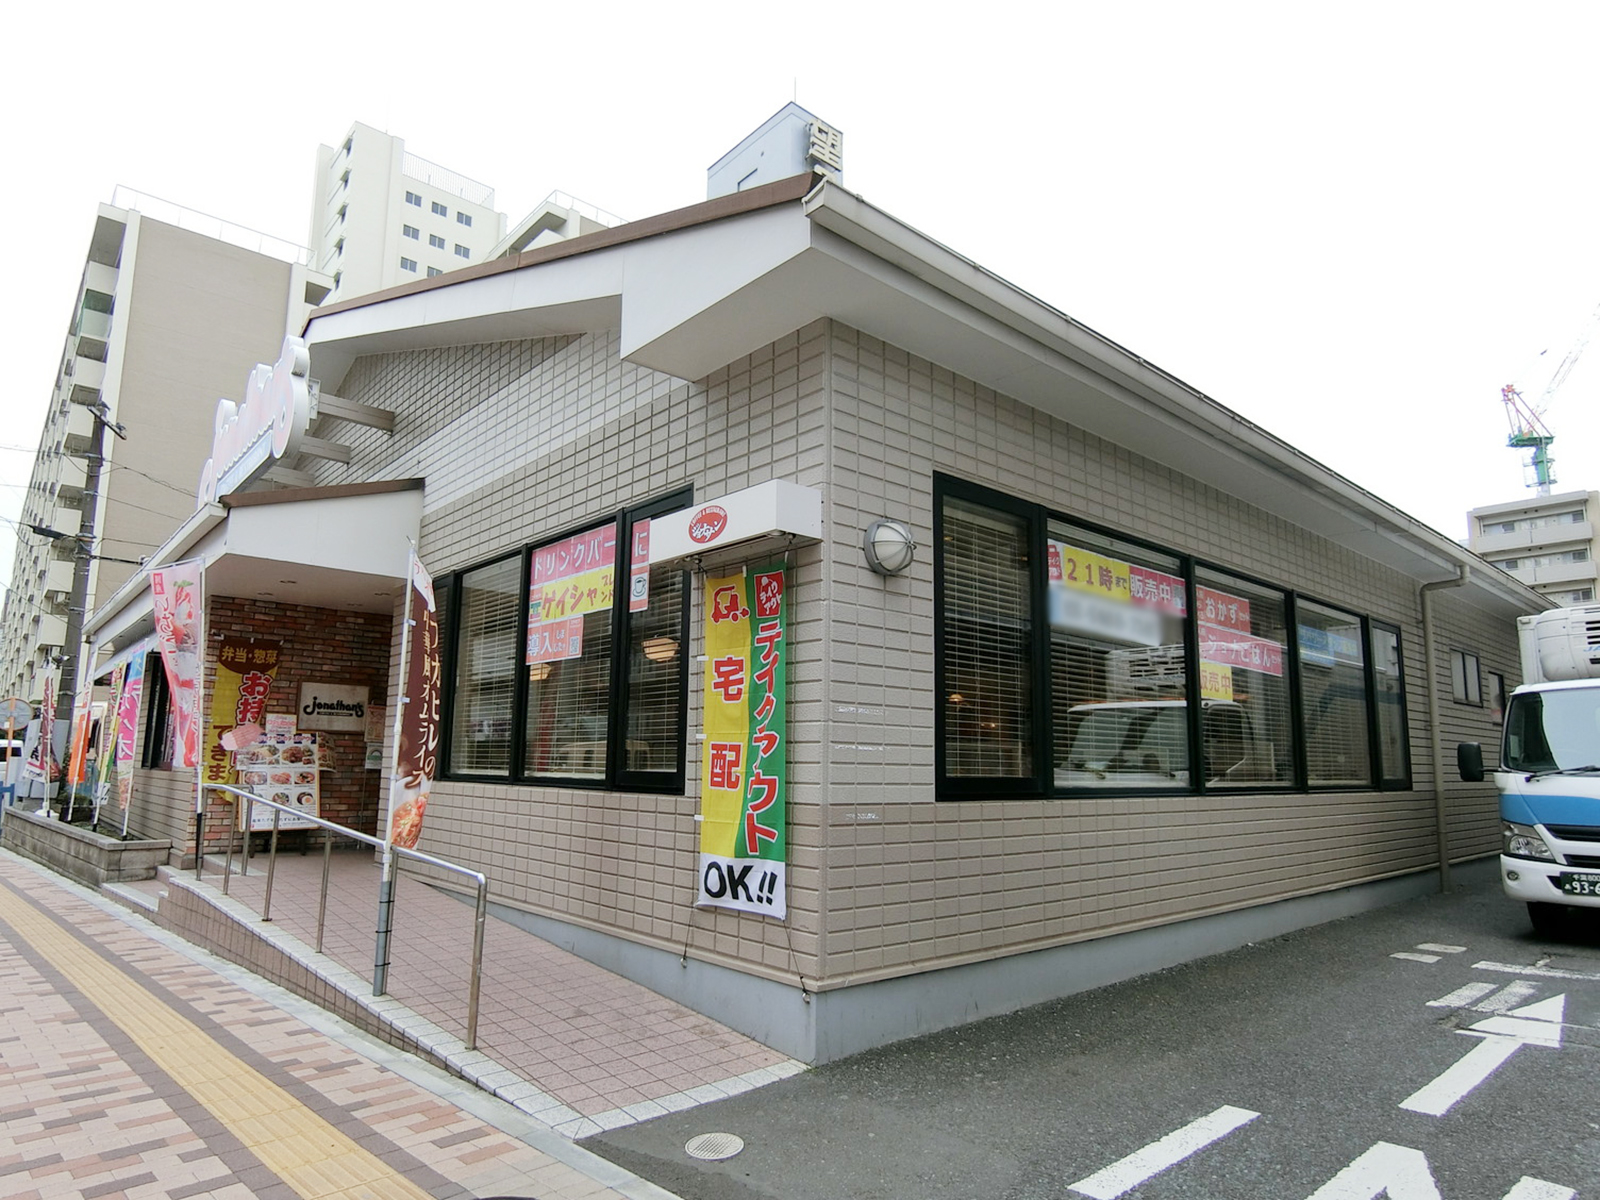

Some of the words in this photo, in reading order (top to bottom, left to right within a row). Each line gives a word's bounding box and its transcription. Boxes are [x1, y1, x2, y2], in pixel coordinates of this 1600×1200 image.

[535, 536, 616, 580] ドリンクバー
[542, 584, 597, 618] ゲイシャ
[1130, 573, 1171, 604] 販売中
[1205, 596, 1238, 624] おかず
[527, 631, 552, 656] 導入
[708, 656, 745, 791] 宅配
[745, 622, 782, 855] テイクアウト
[703, 862, 778, 906] OK!!
